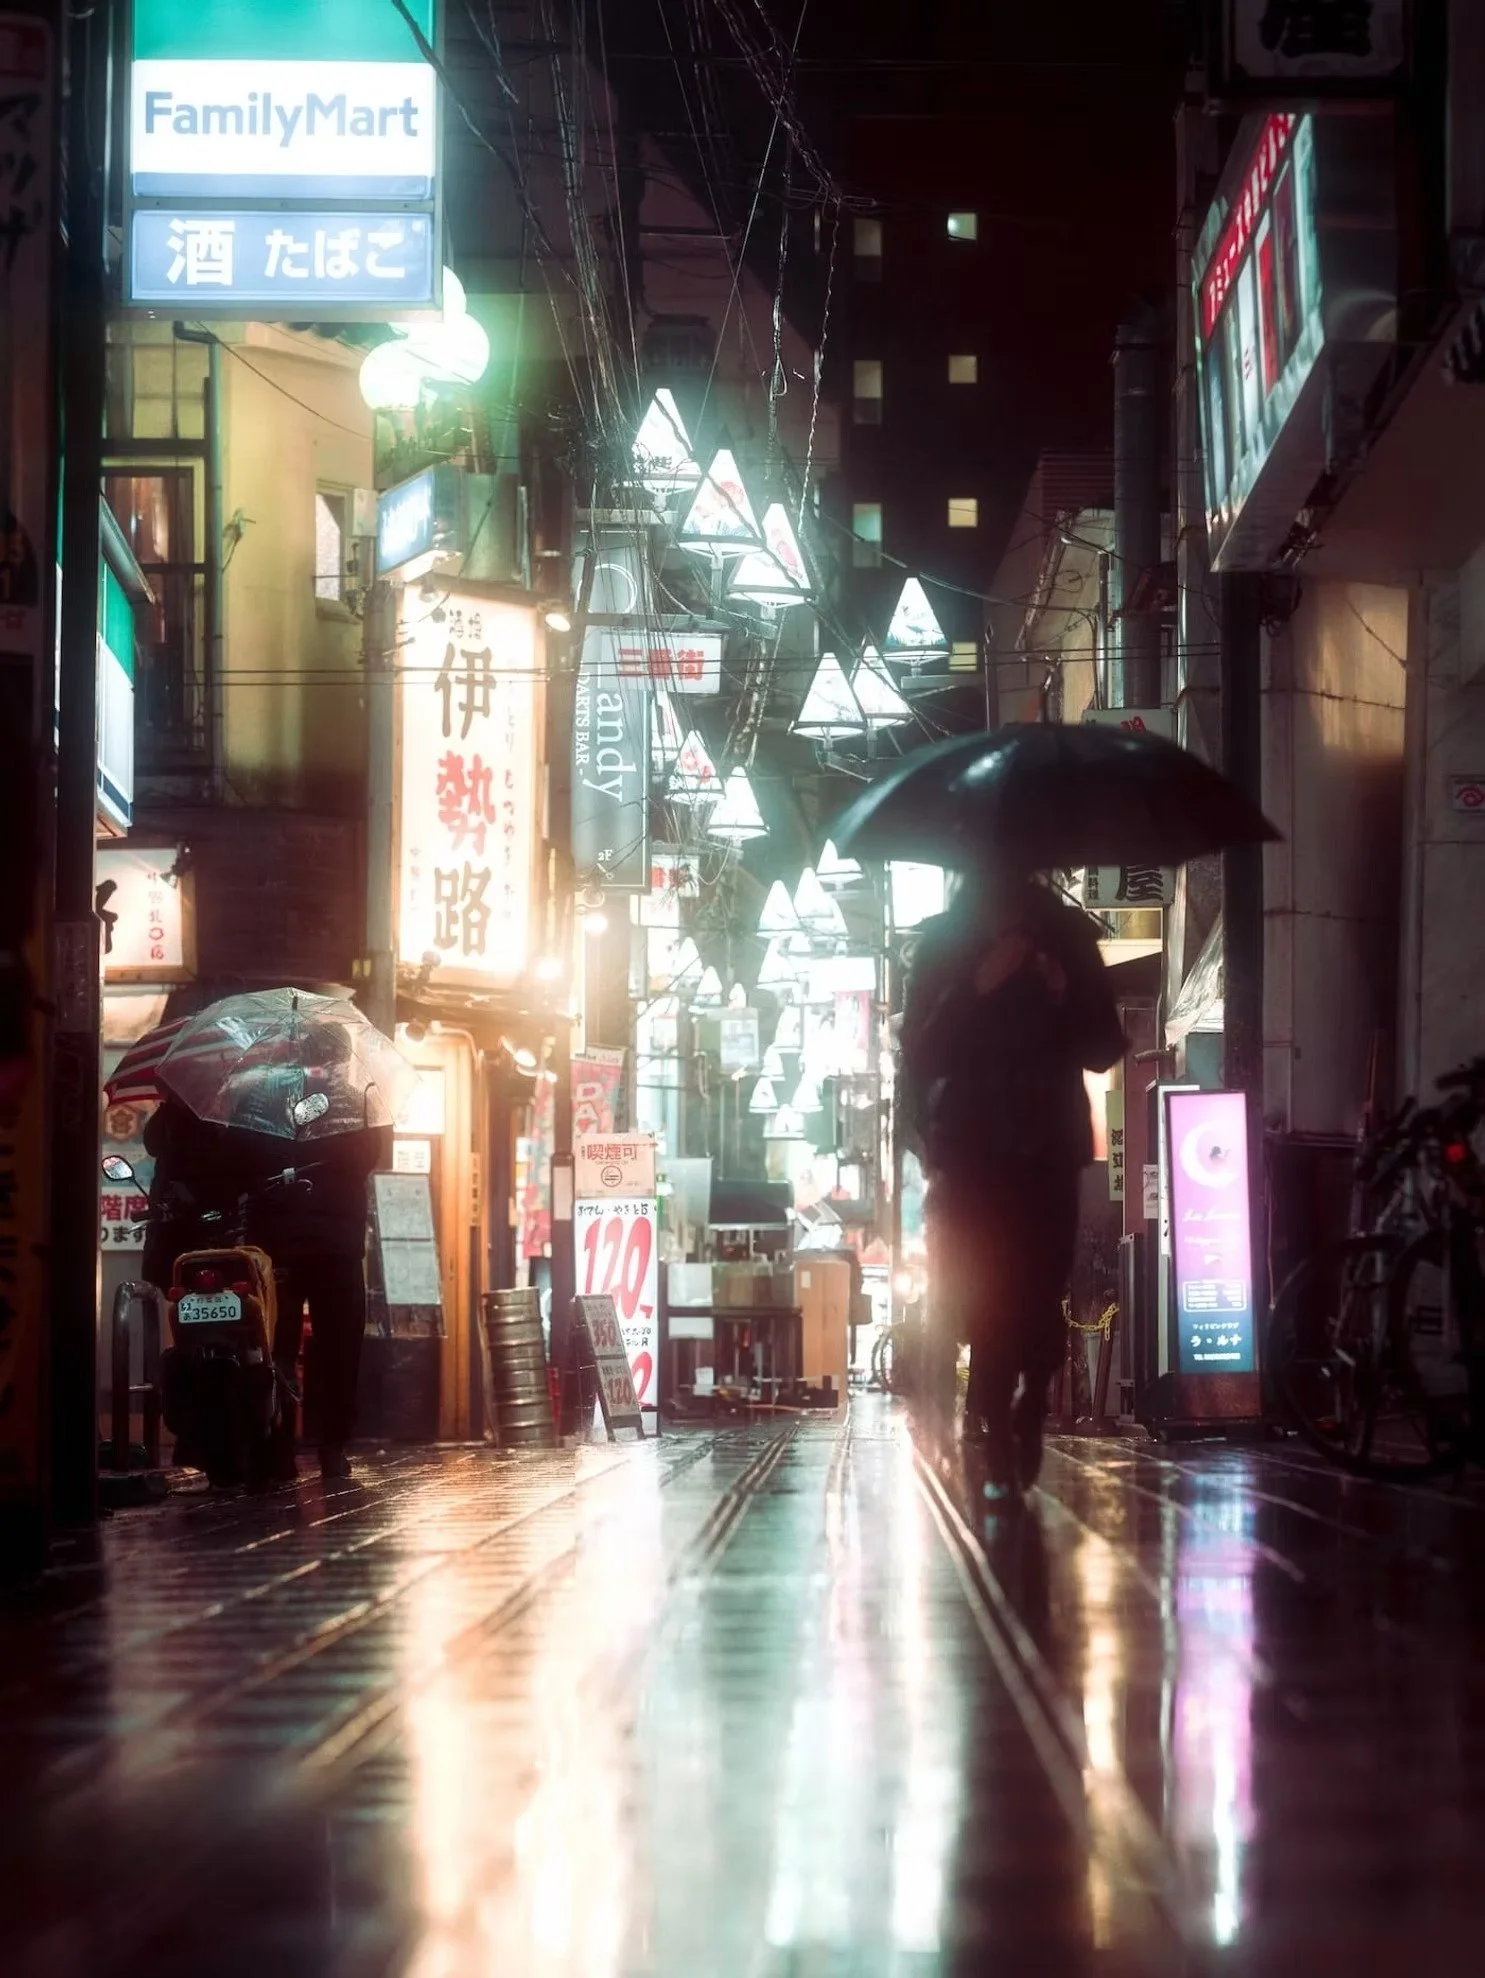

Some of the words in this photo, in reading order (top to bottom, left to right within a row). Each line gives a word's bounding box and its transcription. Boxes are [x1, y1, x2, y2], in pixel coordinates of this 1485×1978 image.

[144, 91, 418, 147] FamilyMart
[166, 219, 235, 286] 酒
[264, 228, 407, 279] たばこ
[618, 648, 704, 681] 三番街
[576, 671, 590, 728] DARTS
[576, 731, 590, 765] BAR
[433, 642, 497, 956] 伊勢路
[587, 1143, 638, 1161] 喫煙可
[193, 1306, 236, 1320] 35650
